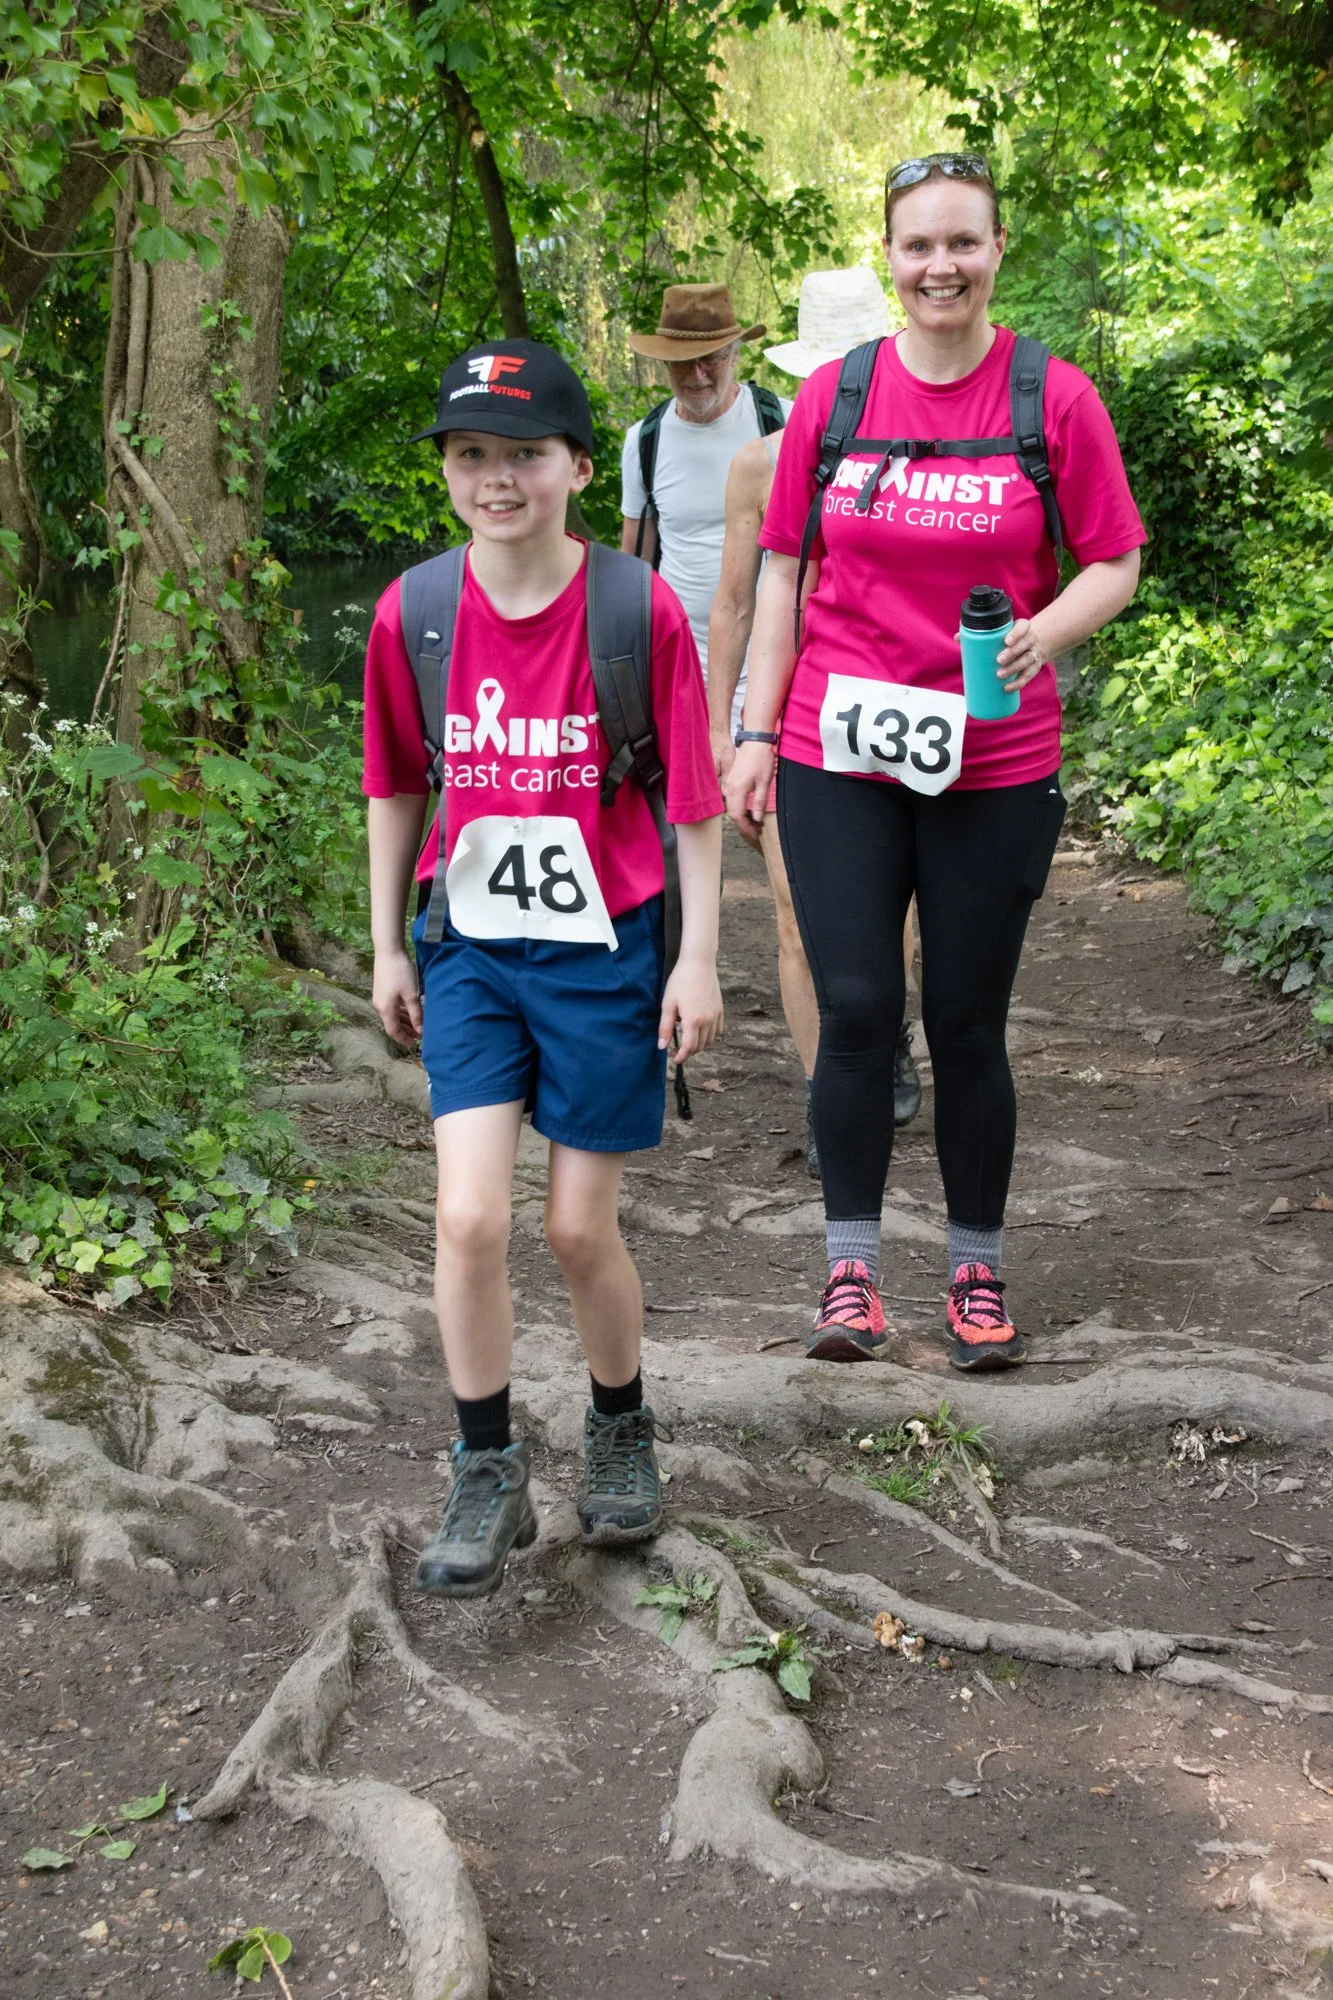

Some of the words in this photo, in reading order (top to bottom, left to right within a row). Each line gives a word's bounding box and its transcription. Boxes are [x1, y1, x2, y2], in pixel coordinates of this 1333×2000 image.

[905, 507, 1002, 534] cancer
[836, 703, 952, 774] 133
[487, 844, 588, 914] 48
